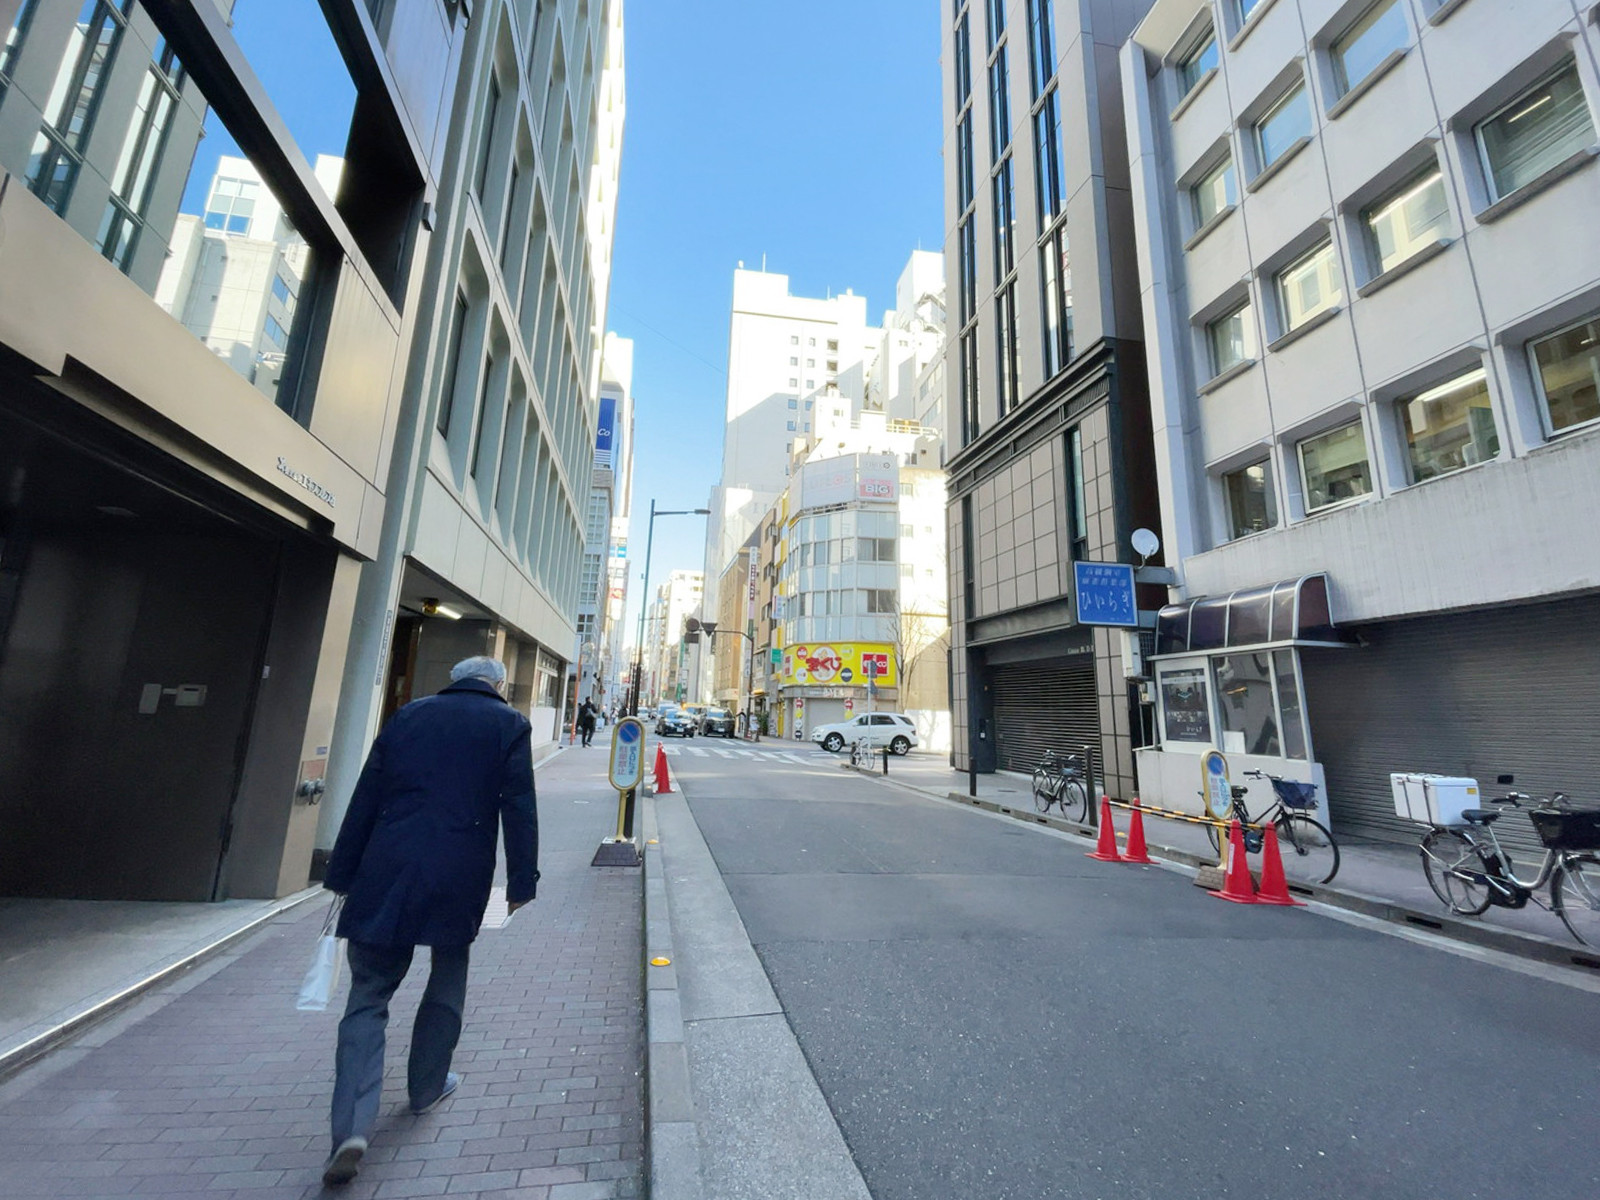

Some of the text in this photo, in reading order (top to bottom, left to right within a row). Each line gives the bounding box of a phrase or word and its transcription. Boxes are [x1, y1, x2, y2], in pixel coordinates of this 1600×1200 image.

[865, 484, 890, 494] BIG
[805, 656, 842, 672] 宝くじ
